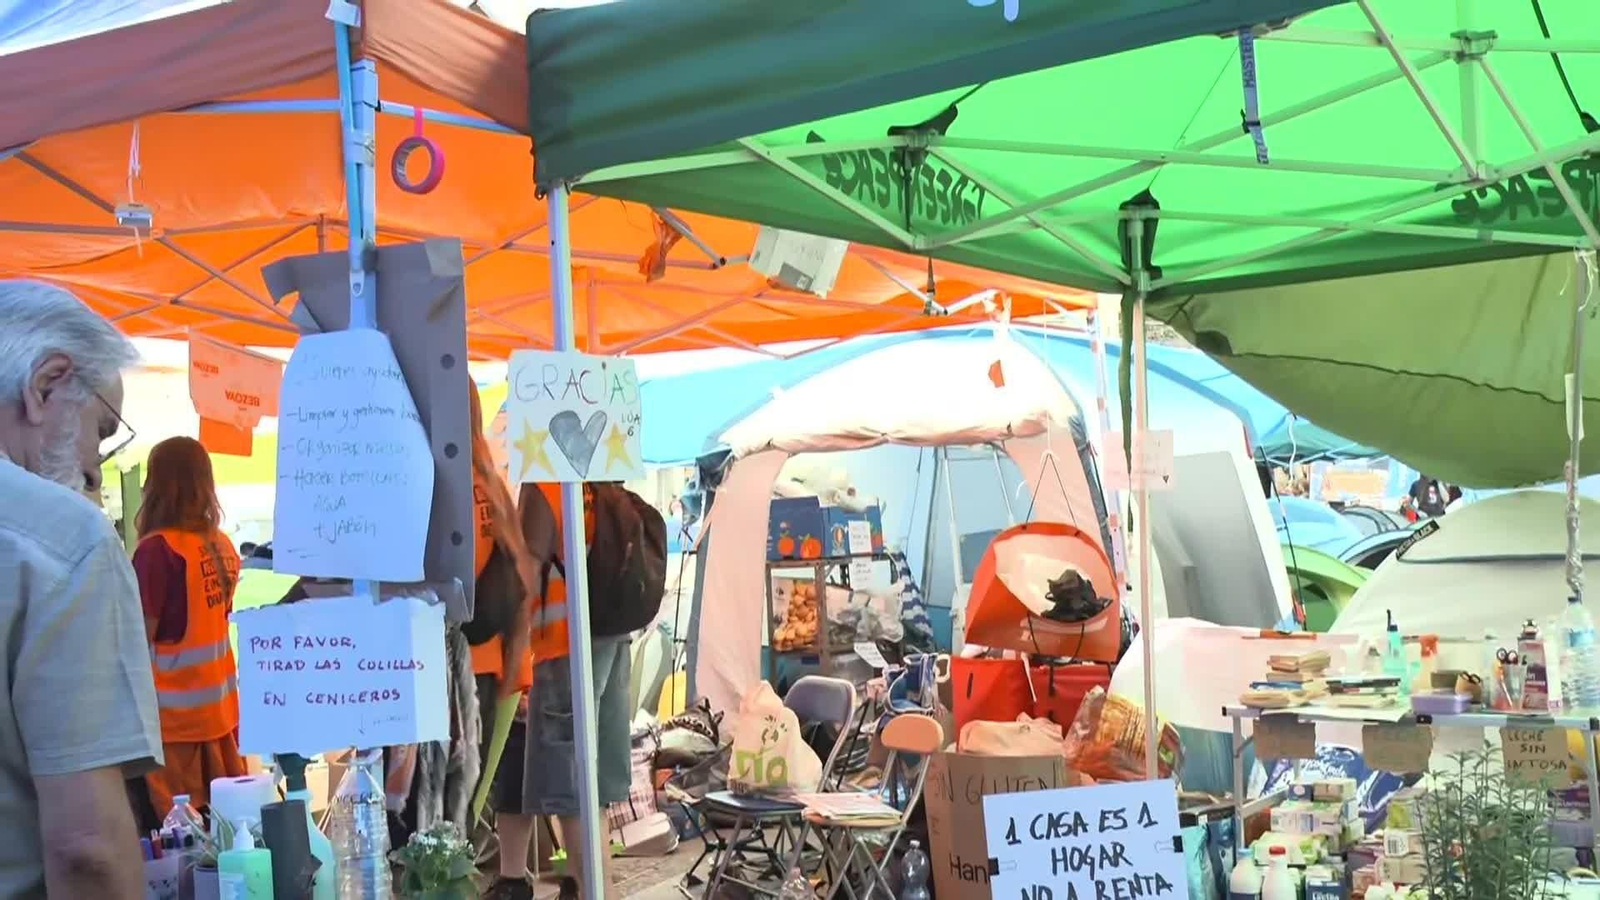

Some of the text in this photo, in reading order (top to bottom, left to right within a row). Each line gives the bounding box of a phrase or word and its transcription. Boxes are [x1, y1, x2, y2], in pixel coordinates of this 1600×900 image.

[515, 361, 639, 405] GRACIAS
[225, 390, 260, 407] BEZOYA
[627, 426, 634, 437] 6
[250, 635, 357, 653] POR FAVOR,
[257, 659, 306, 671] TIRAD
[315, 658, 342, 671] LAS
[263, 688, 401, 707] EN CENICEROS
[1519, 743, 1546, 754] SIN
[1005, 801, 1158, 846] 1 CASA ES 1
[1051, 841, 1133, 881] HOGAR
[1021, 872, 1173, 900] NO A RENTA
